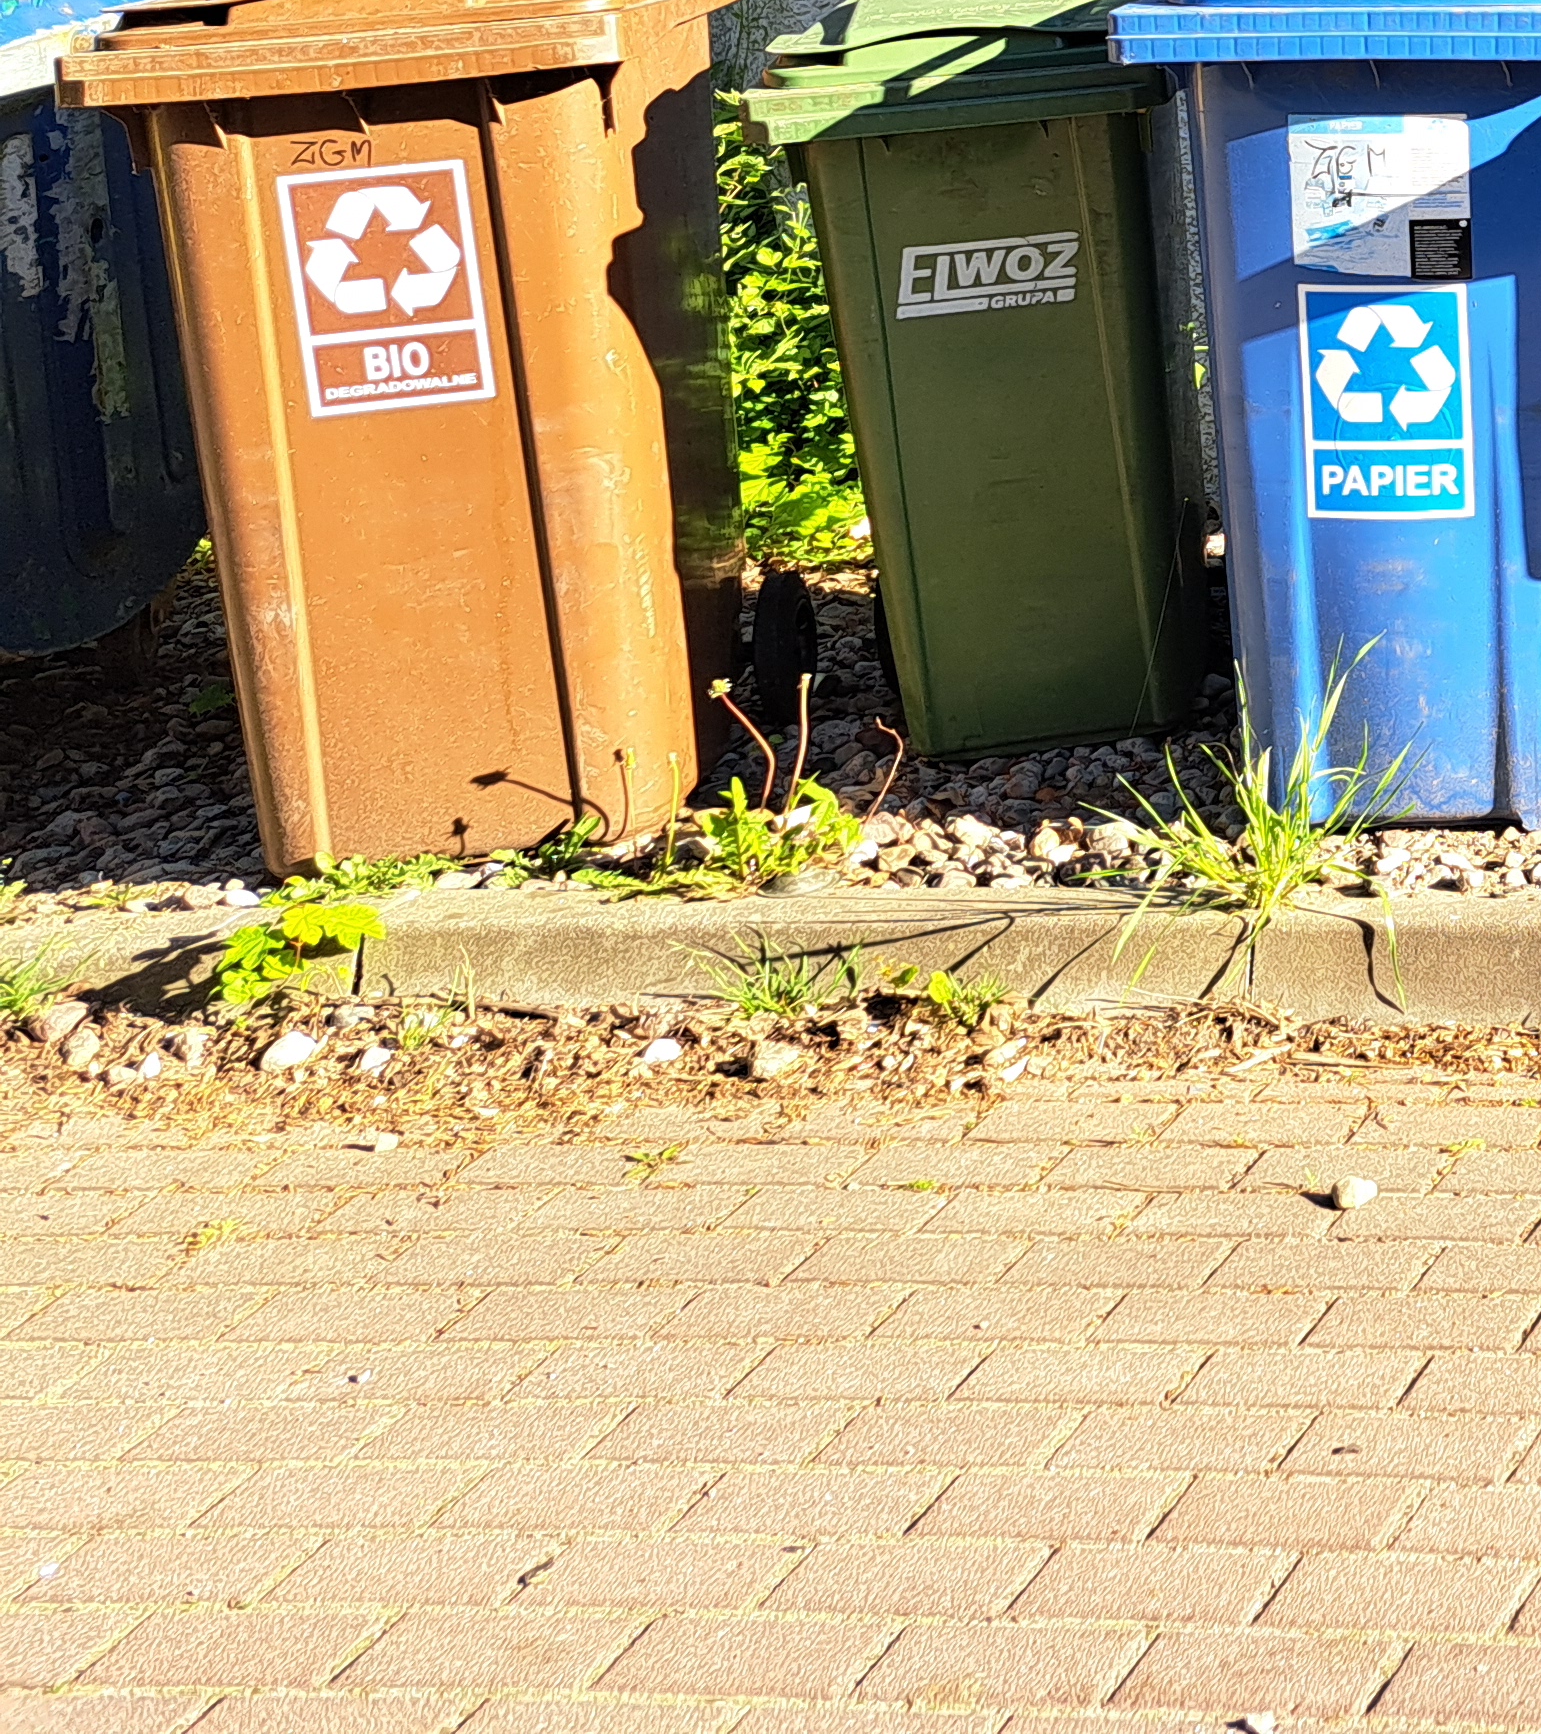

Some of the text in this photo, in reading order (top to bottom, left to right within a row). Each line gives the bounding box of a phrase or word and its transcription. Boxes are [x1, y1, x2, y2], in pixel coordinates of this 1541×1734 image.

[290, 139, 372, 167] ZGM
[1304, 139, 1387, 180] ZGM
[898, 231, 1080, 305] ELWOZ
[990, 290, 1056, 310] GRUPA
[362, 341, 431, 382] BIO
[324, 372, 479, 402] DEGRADOWALNE
[1321, 463, 1460, 497] PAPIER
